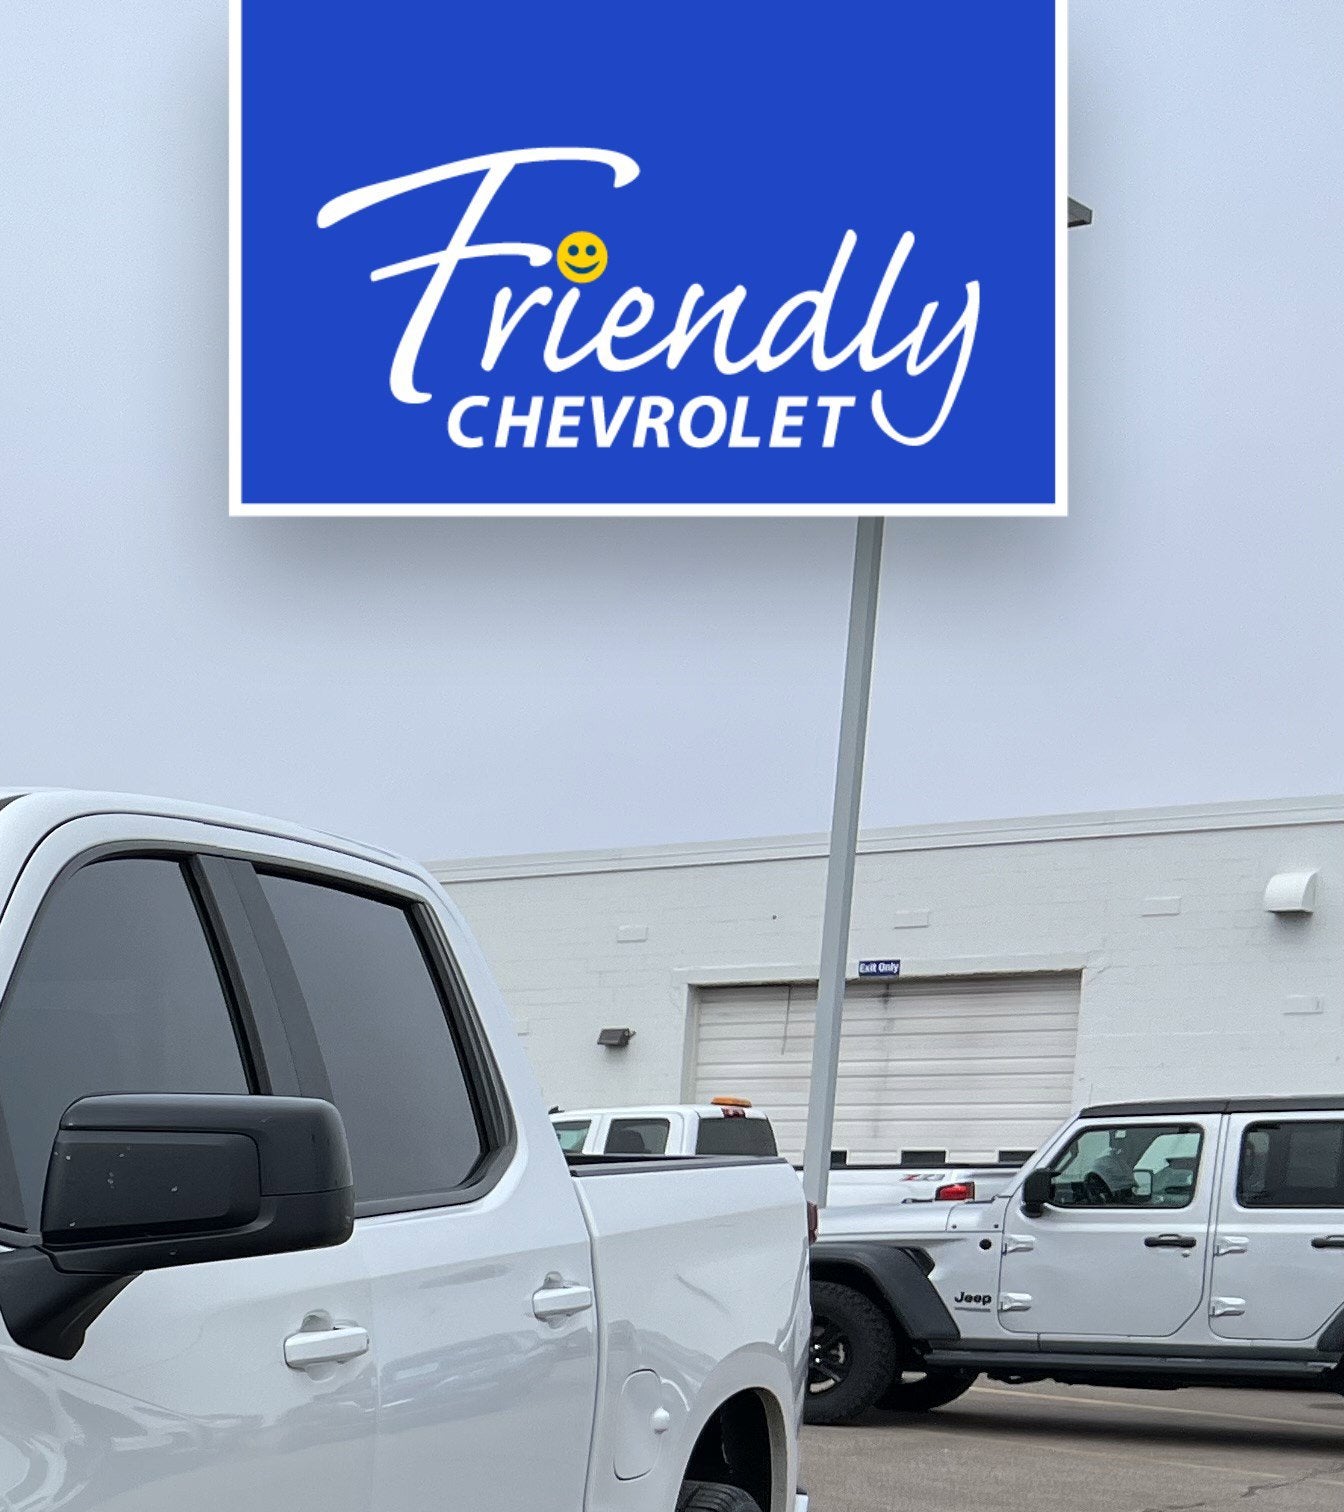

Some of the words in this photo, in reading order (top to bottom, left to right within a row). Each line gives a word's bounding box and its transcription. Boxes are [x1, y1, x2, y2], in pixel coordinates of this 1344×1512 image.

[859, 963, 877, 973] Exit
[878, 962, 899, 974] Only
[954, 1291, 992, 1305] Jeep
